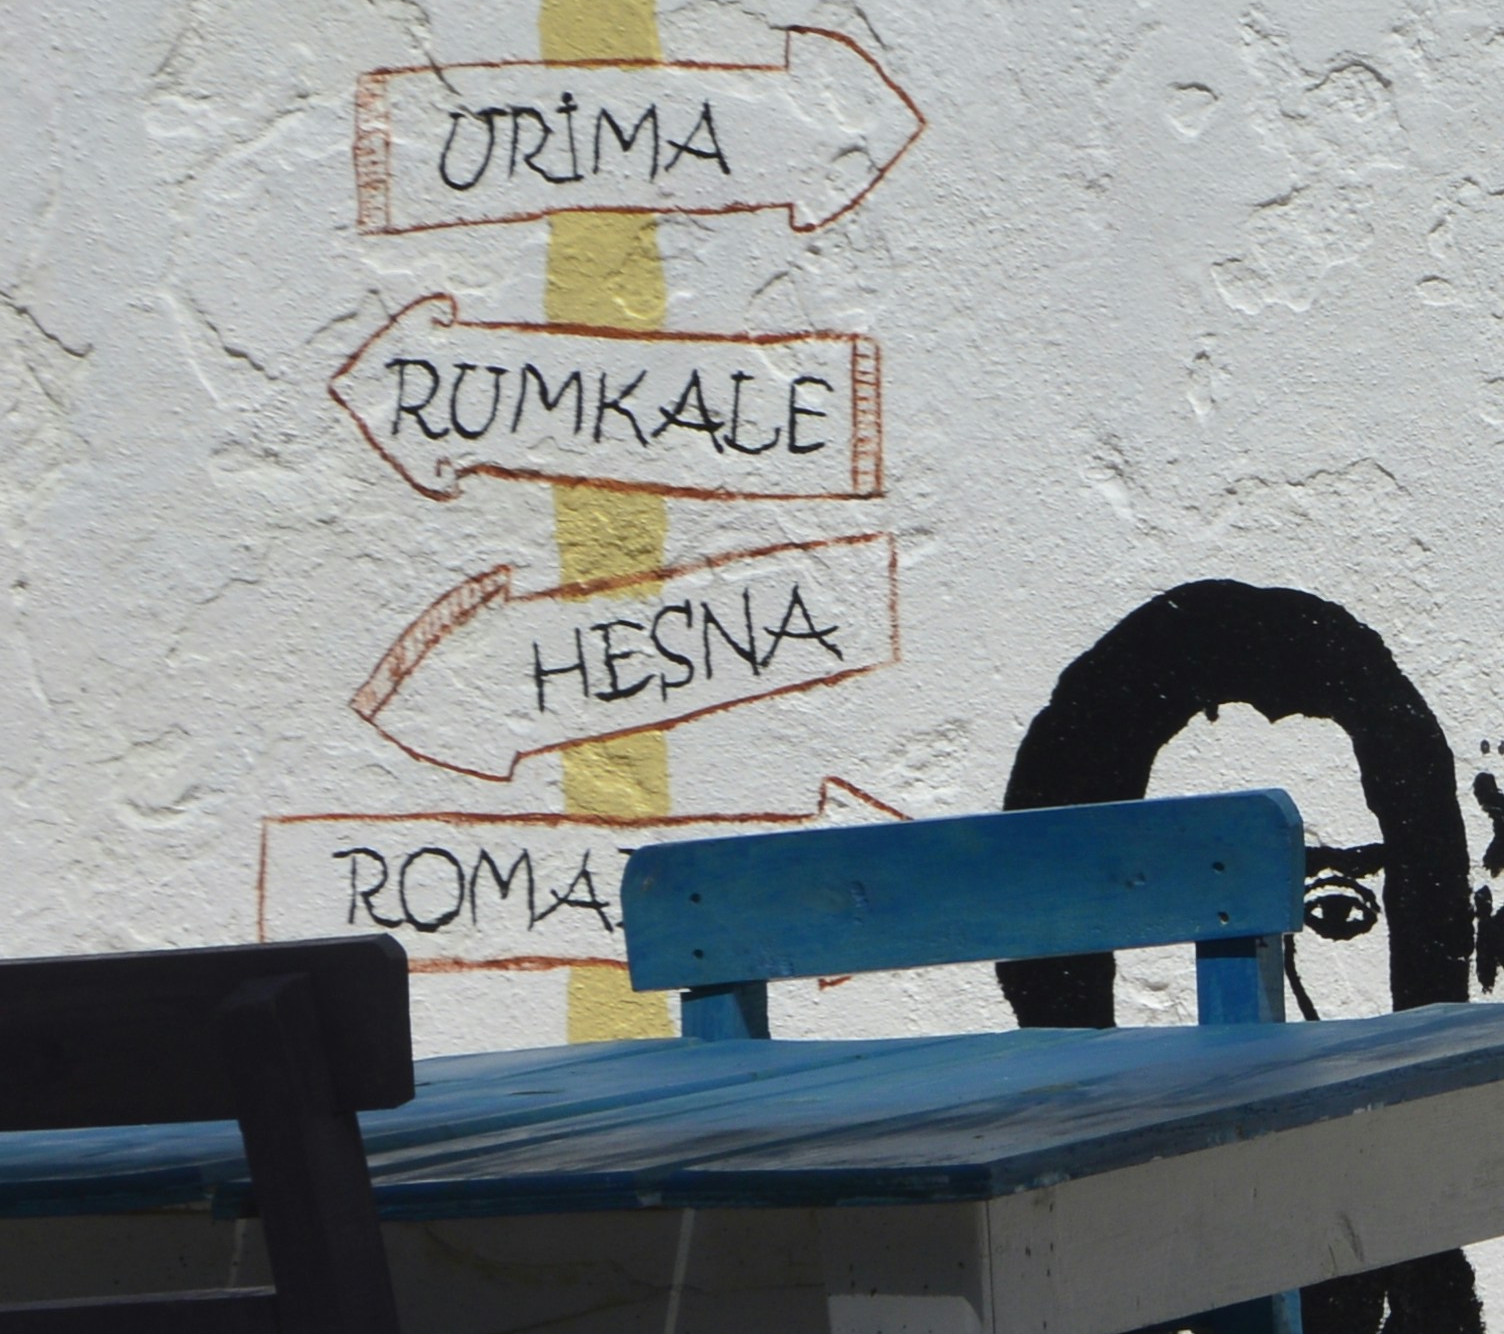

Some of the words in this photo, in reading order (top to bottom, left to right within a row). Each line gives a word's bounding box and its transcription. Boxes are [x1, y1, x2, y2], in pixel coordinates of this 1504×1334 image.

[381, 358, 833, 454] RUMKALE
[534, 587, 851, 712] HESNA
[334, 848, 637, 934] ROMA
